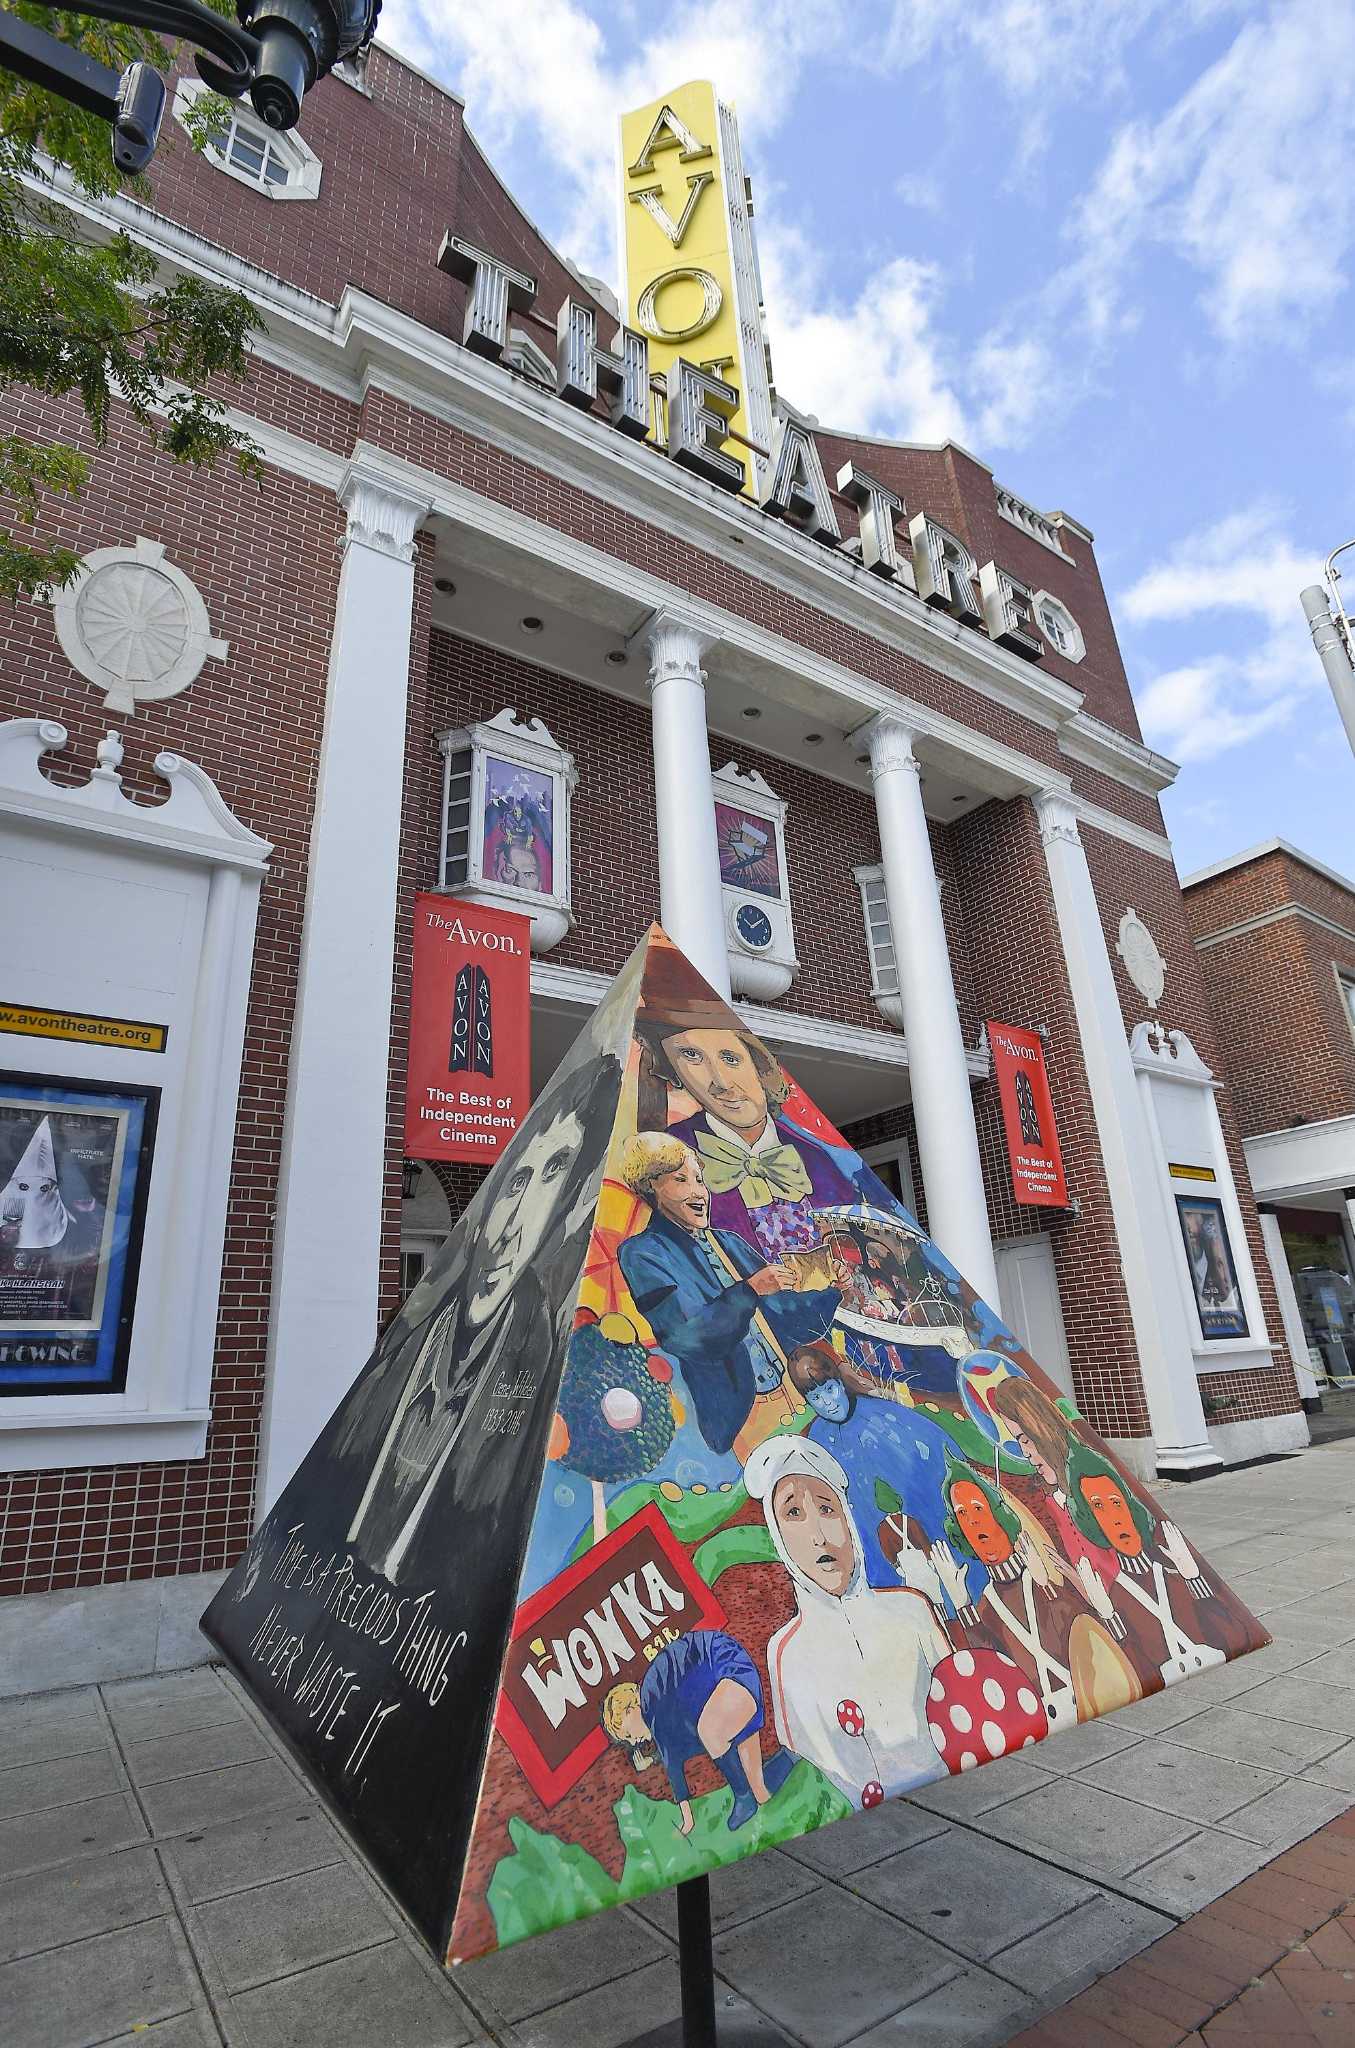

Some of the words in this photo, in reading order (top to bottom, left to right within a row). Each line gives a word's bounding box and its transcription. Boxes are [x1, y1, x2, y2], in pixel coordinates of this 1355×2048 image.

[437, 228, 1044, 663] THEATRE
[425, 912, 453, 931] The
[447, 918, 522, 956] Avon.
[452, 973, 469, 1062] AVON
[475, 978, 492, 1066] AVON
[994, 1035, 1007, 1047] The
[1005, 1038, 1039, 1062] Avon.
[419, 1106, 516, 1129] Independent
[426, 1086, 455, 1103] The
[459, 1091, 492, 1108] Best
[496, 1096, 512, 1110] of
[1015, 1076, 1030, 1138] AVON
[1024, 1080, 1041, 1139] AVON
[439, 1128, 497, 1145] Cinema
[1016, 1156, 1030, 1167] The
[1030, 1157, 1046, 1169] Best
[1046, 1159, 1054, 1169] of
[1016, 1169, 1058, 1182] Independent
[1027, 1181, 1053, 1193] Cinema
[269, 1522, 309, 1589] TIME
[299, 1551, 322, 1590] IS
[309, 1552, 337, 1597] A
[323, 1554, 410, 1645] PRECIOUS
[391, 1589, 468, 1707] THING
[520, 1560, 685, 1730] WONKA
[642, 1626, 681, 1663] BAR
[248, 1603, 306, 1694] NEVER
[293, 1640, 361, 1740] WASTE
